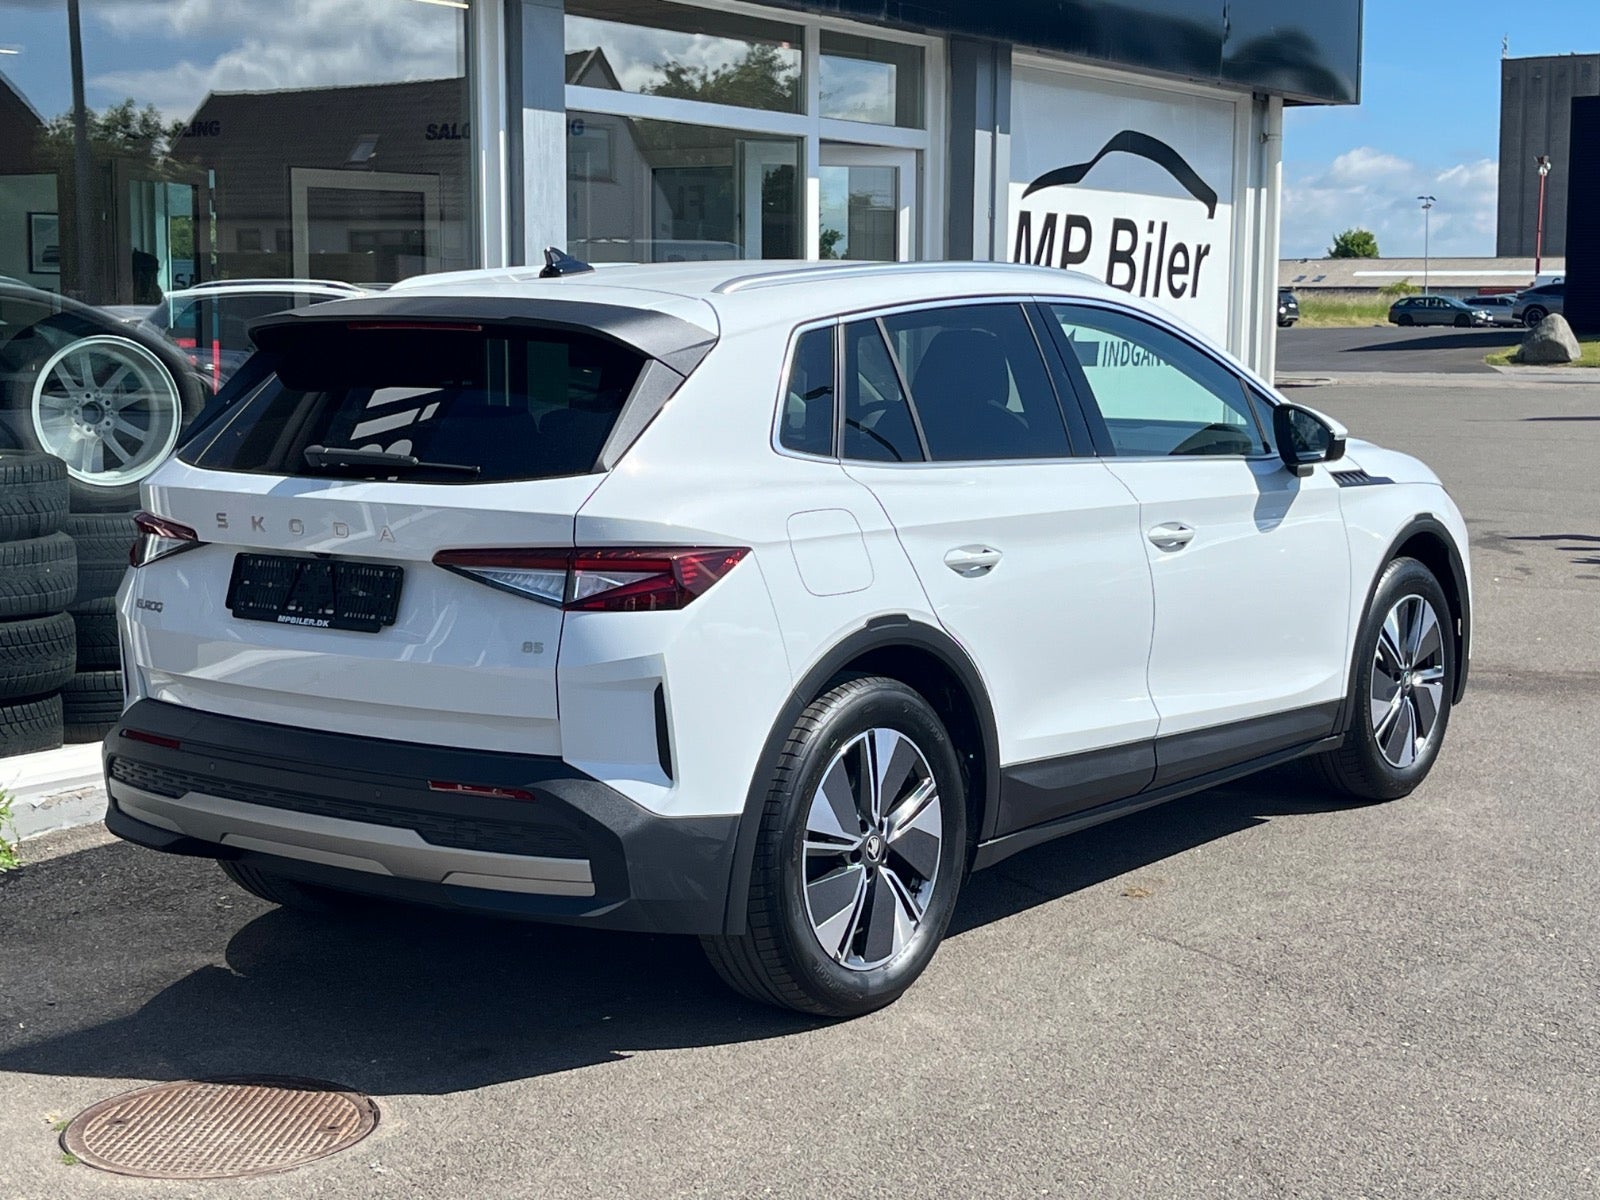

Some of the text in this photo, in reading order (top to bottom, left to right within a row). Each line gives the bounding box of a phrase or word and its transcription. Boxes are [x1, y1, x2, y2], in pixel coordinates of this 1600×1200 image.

[1013, 210, 1211, 299] MP Biler
[215, 512, 396, 543] SKODA
[277, 614, 330, 628] MPBILER.DK
[522, 641, 545, 655] 85
